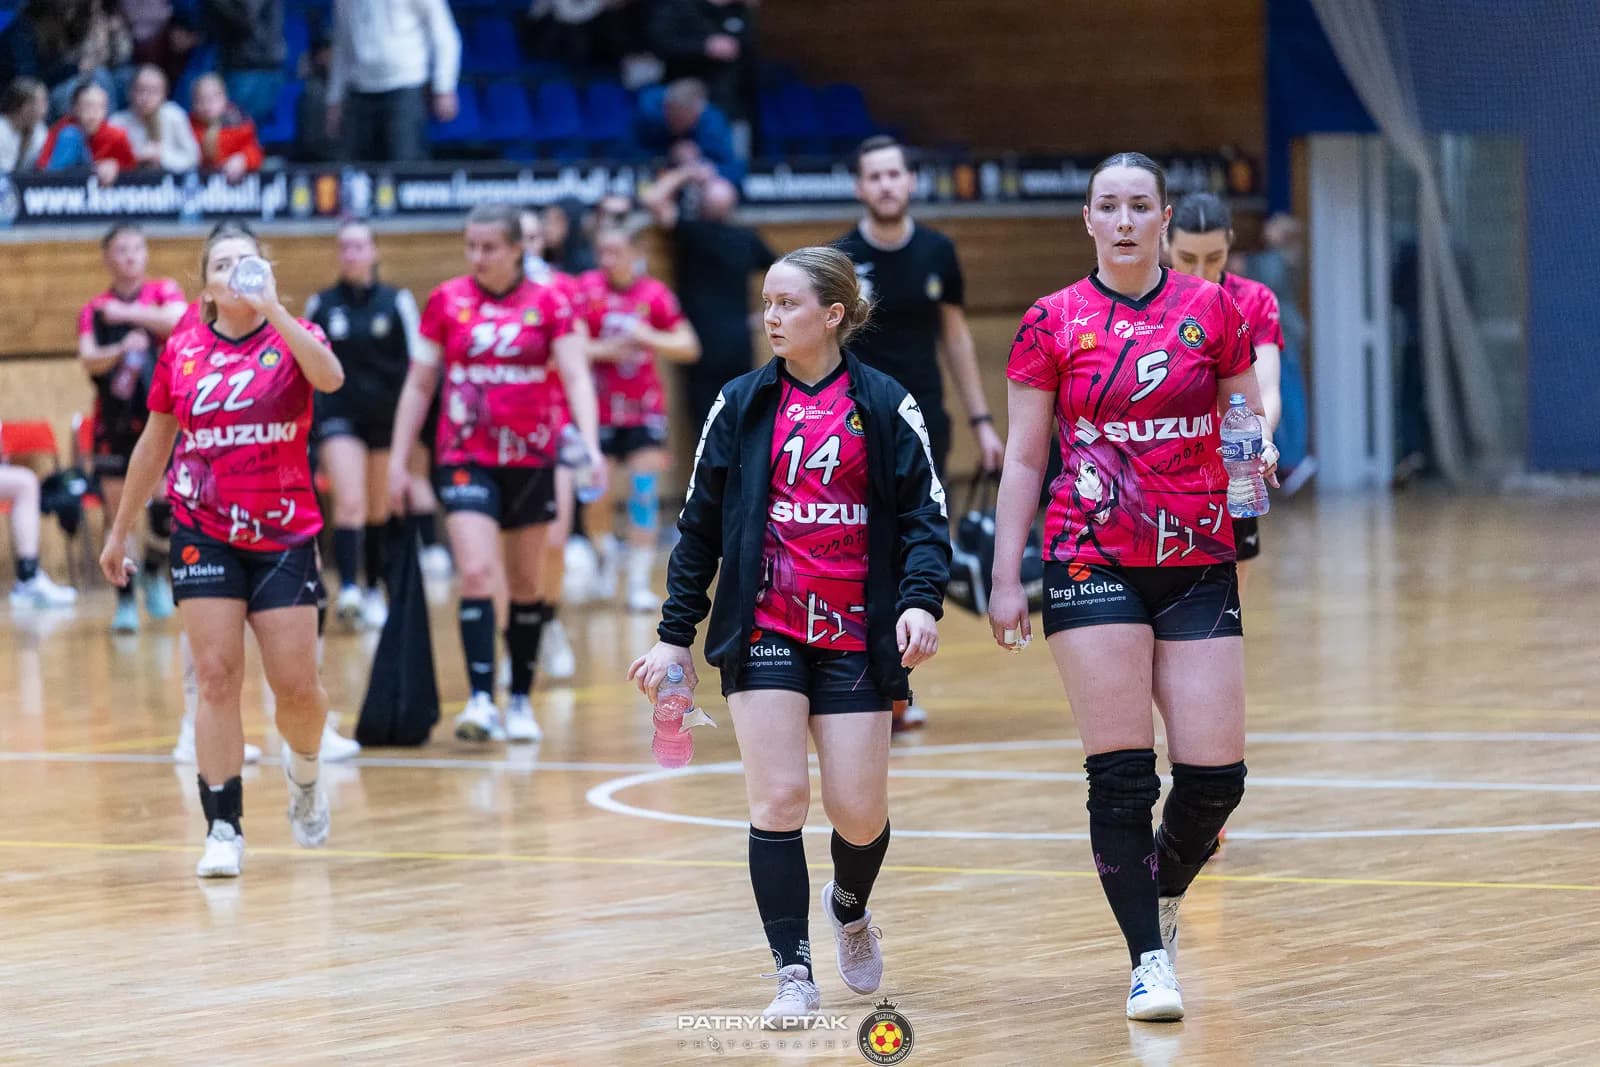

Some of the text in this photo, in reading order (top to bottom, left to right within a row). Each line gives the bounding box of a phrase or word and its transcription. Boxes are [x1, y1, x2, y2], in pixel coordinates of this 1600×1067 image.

[1130, 350, 1169, 402] 5
[191, 368, 255, 416] 22
[195, 422, 297, 449] SUZUKI
[1103, 413, 1213, 442] SUZUKI
[783, 435, 841, 486] 14
[1049, 581, 1124, 600] Targi Kielce
[750, 644, 791, 657] Kielce
